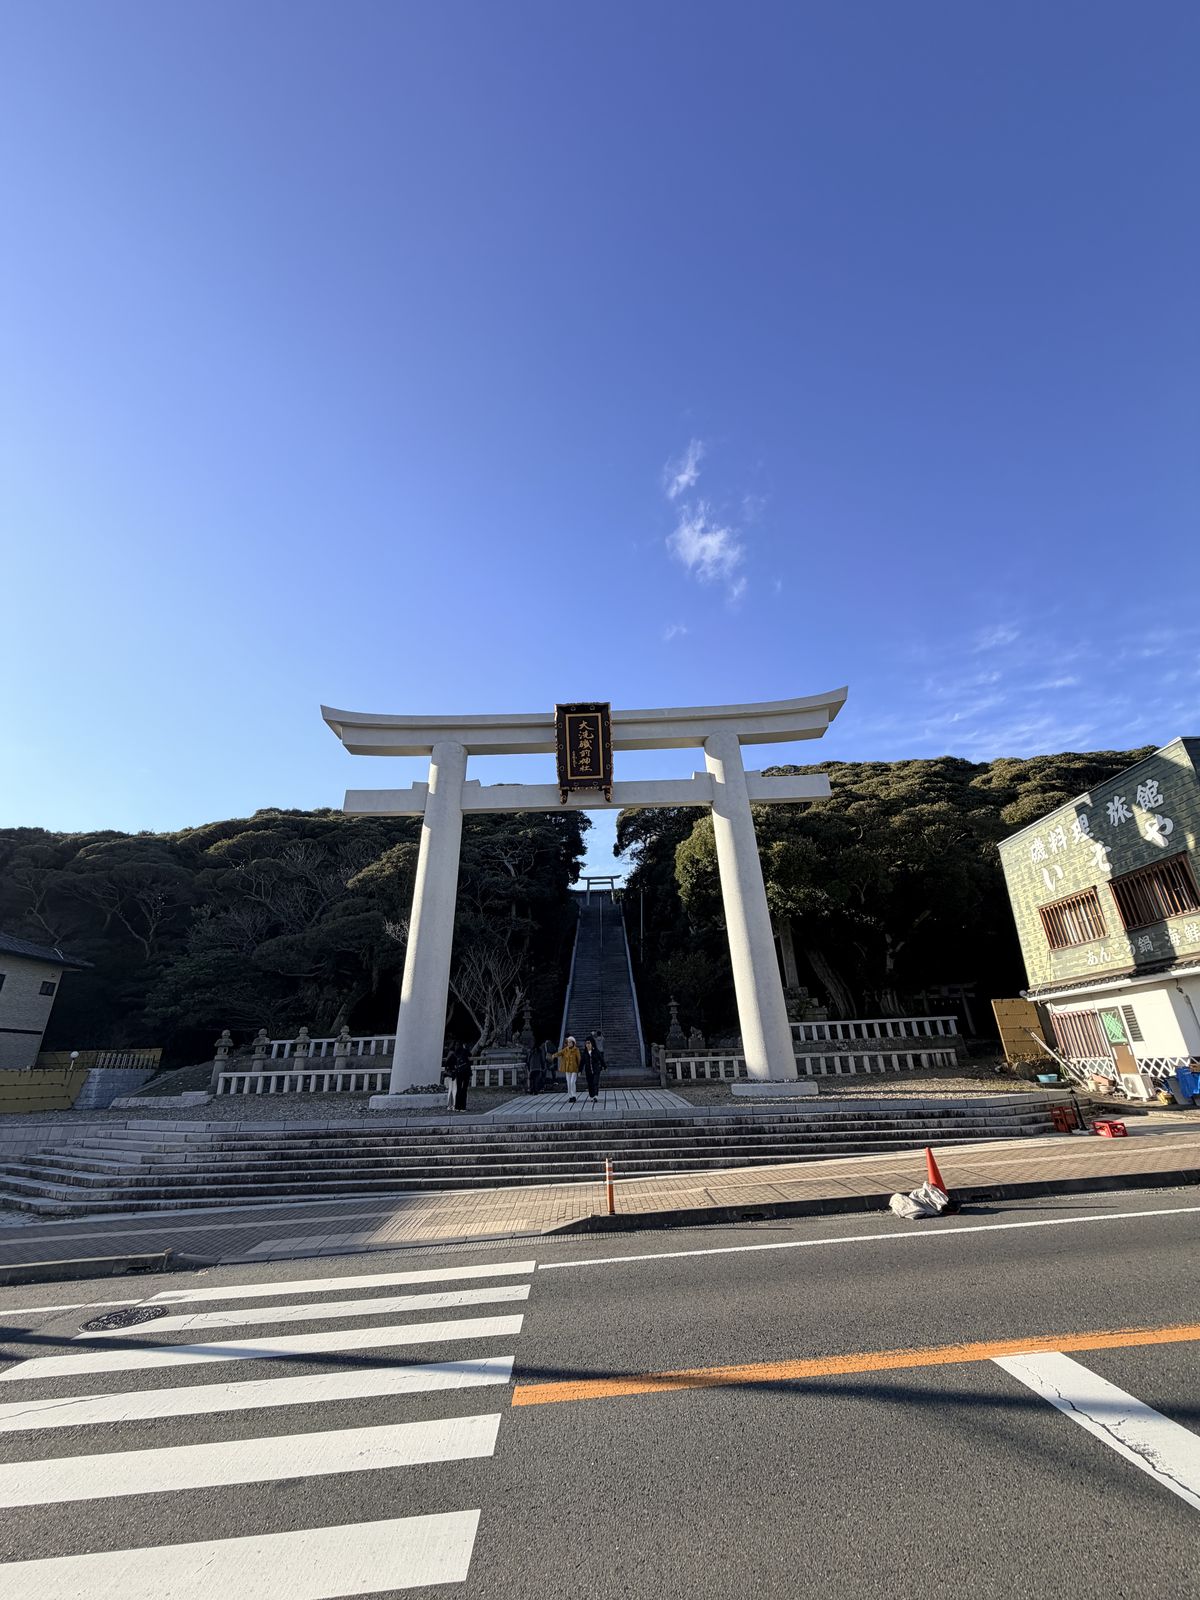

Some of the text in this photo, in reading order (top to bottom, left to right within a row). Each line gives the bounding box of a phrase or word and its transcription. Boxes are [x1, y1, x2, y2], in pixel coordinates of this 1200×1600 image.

[578, 720, 594, 771] 大洗磯前神社
